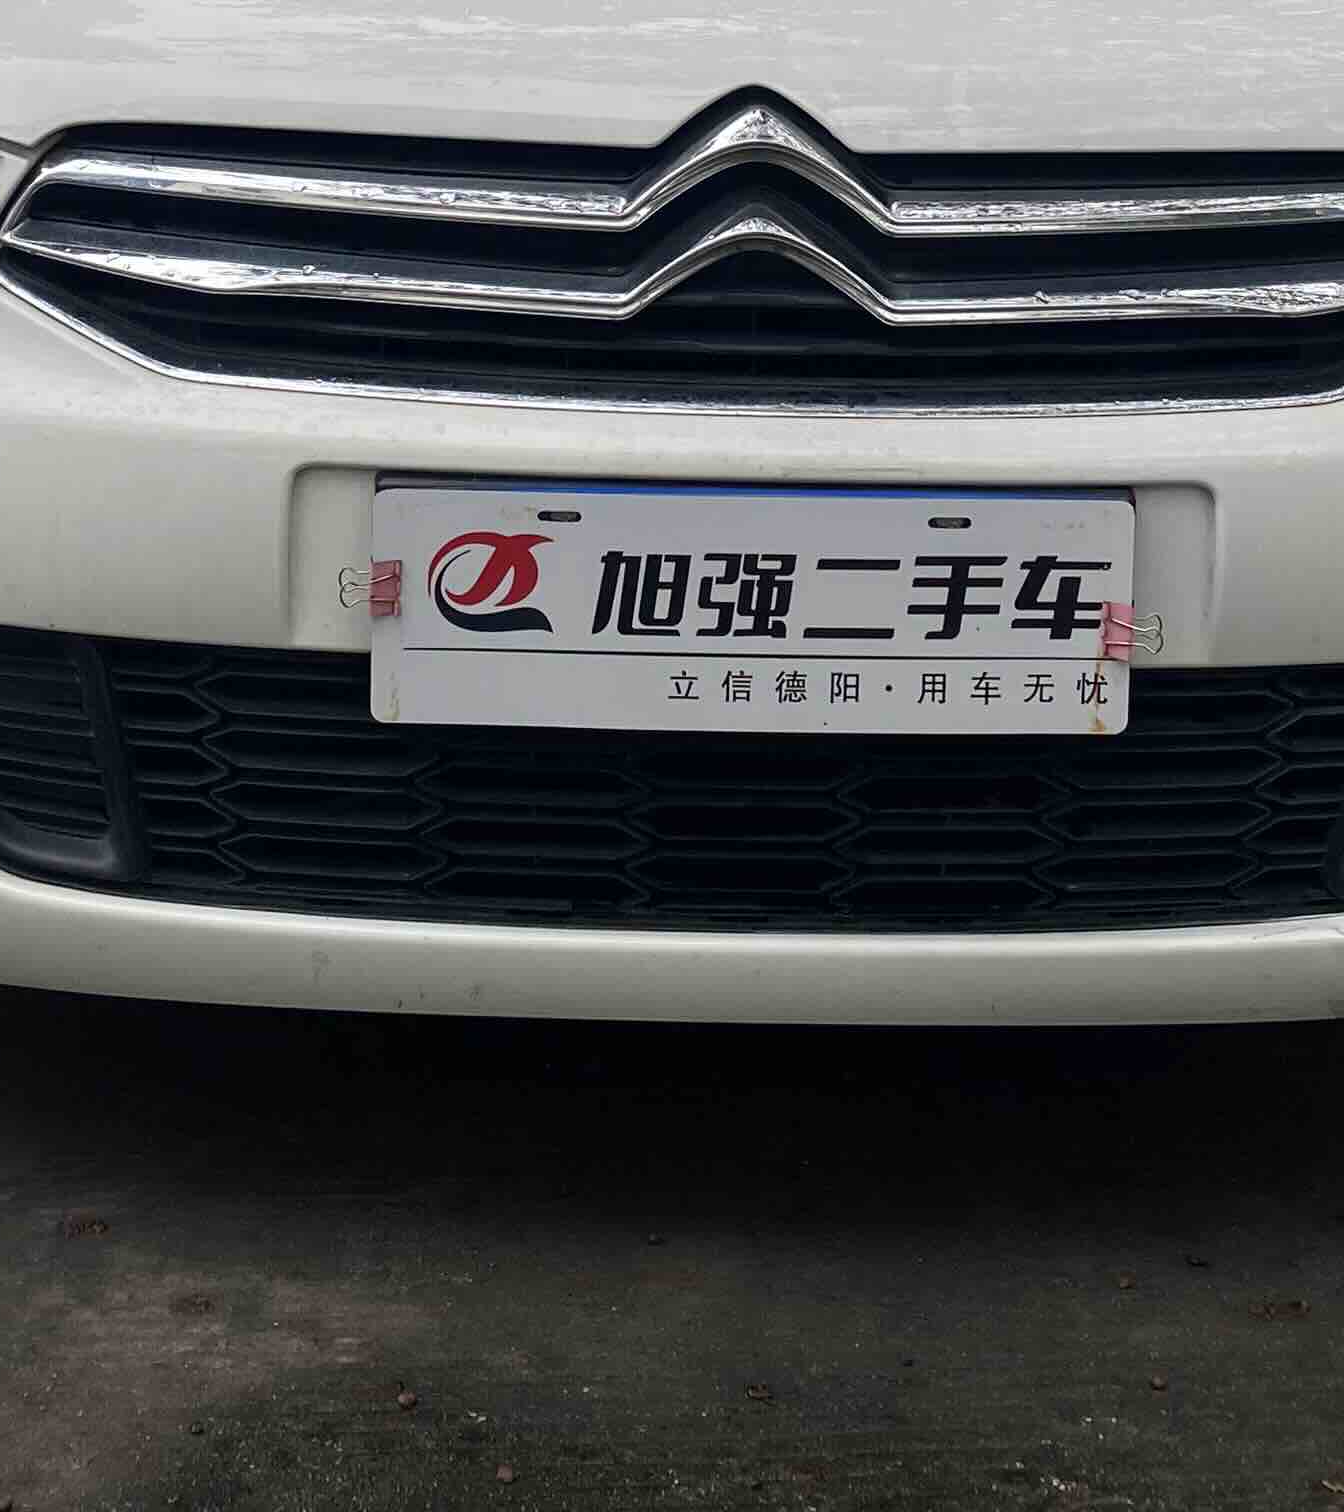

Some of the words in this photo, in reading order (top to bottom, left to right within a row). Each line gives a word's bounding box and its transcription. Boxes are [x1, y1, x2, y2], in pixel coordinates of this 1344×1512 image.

[592, 550, 1112, 640] 旭强二手车
[667, 670, 1109, 705] 立信德阳·用车无忧
